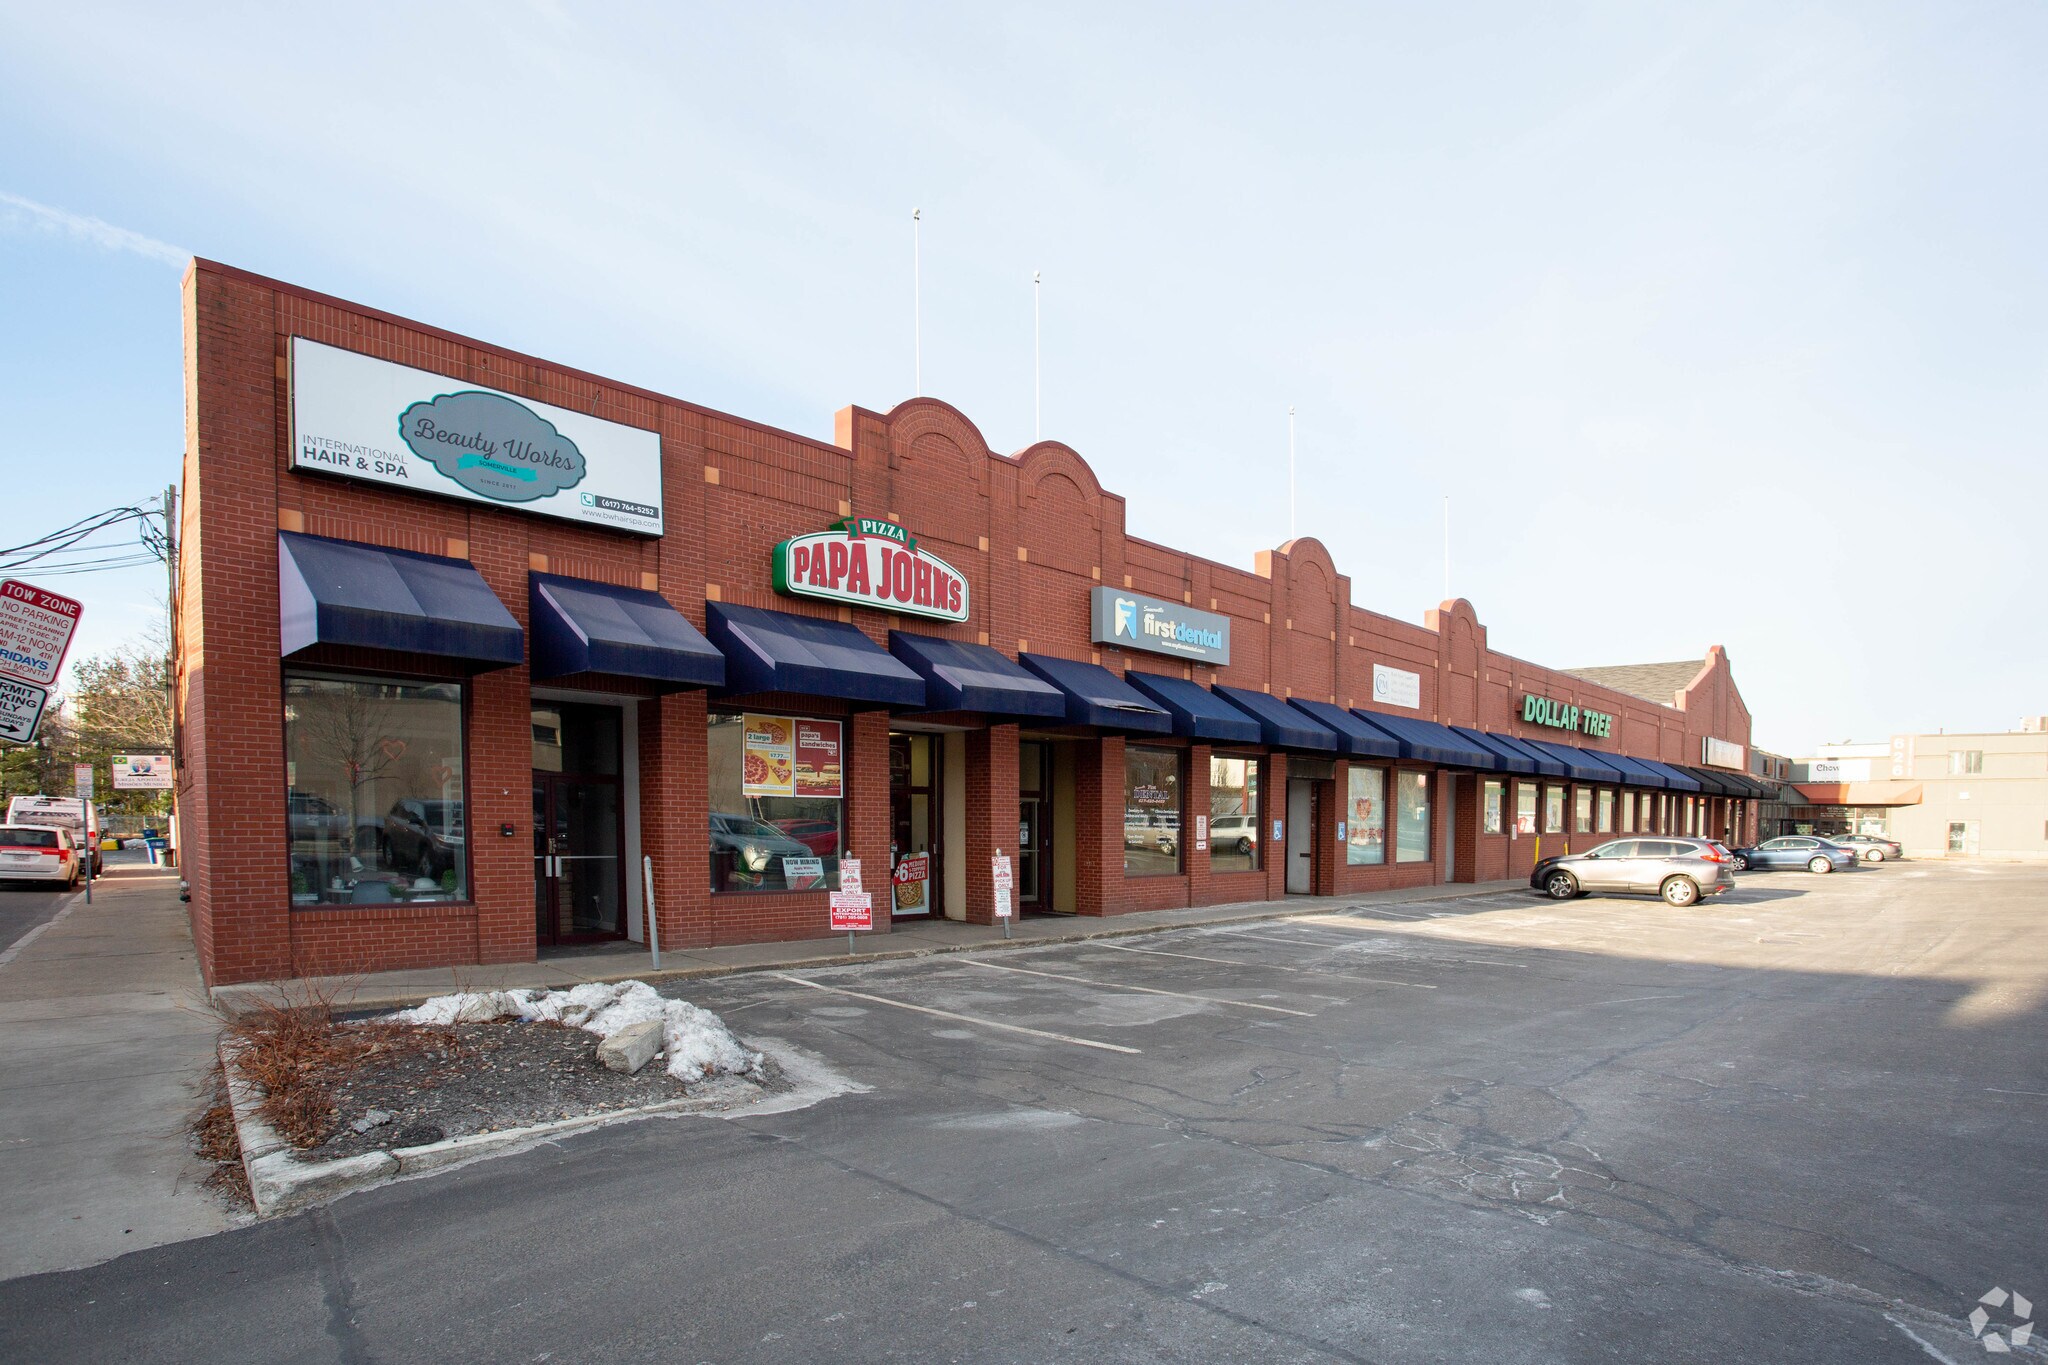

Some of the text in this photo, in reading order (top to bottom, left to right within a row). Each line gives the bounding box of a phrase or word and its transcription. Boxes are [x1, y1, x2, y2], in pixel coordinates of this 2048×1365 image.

[303, 434, 408, 465] INTERNATIONAL
[414, 418, 575, 471] Beauty Works
[303, 446, 409, 479] HAIR & SPA
[479, 459, 517, 474] SOMERVILLE
[480, 478, 500, 487] SINCE
[601, 499, 654, 515] (617) 764-5252
[581, 509, 660, 528] www.bwhairspa.com
[862, 519, 905, 542] PIZZA
[793, 541, 962, 613] PAPA JOHN'S
[7, 583, 79, 616] TOW ZONE
[2, 600, 69, 629] NO PARKING
[0, 612, 65, 637] STREET CLEANING
[0, 620, 19, 630] APRIL
[16, 644, 31, 654] AND
[38, 651, 53, 661] 4TH
[29, 638, 62, 655] NOON
[14, 662, 50, 679] MONTH
[1524, 694, 1613, 738] DOLLAR TREE
[753, 734, 770, 742] large
[841, 860, 848, 869] 10
[909, 871, 925, 881] PIZZA
